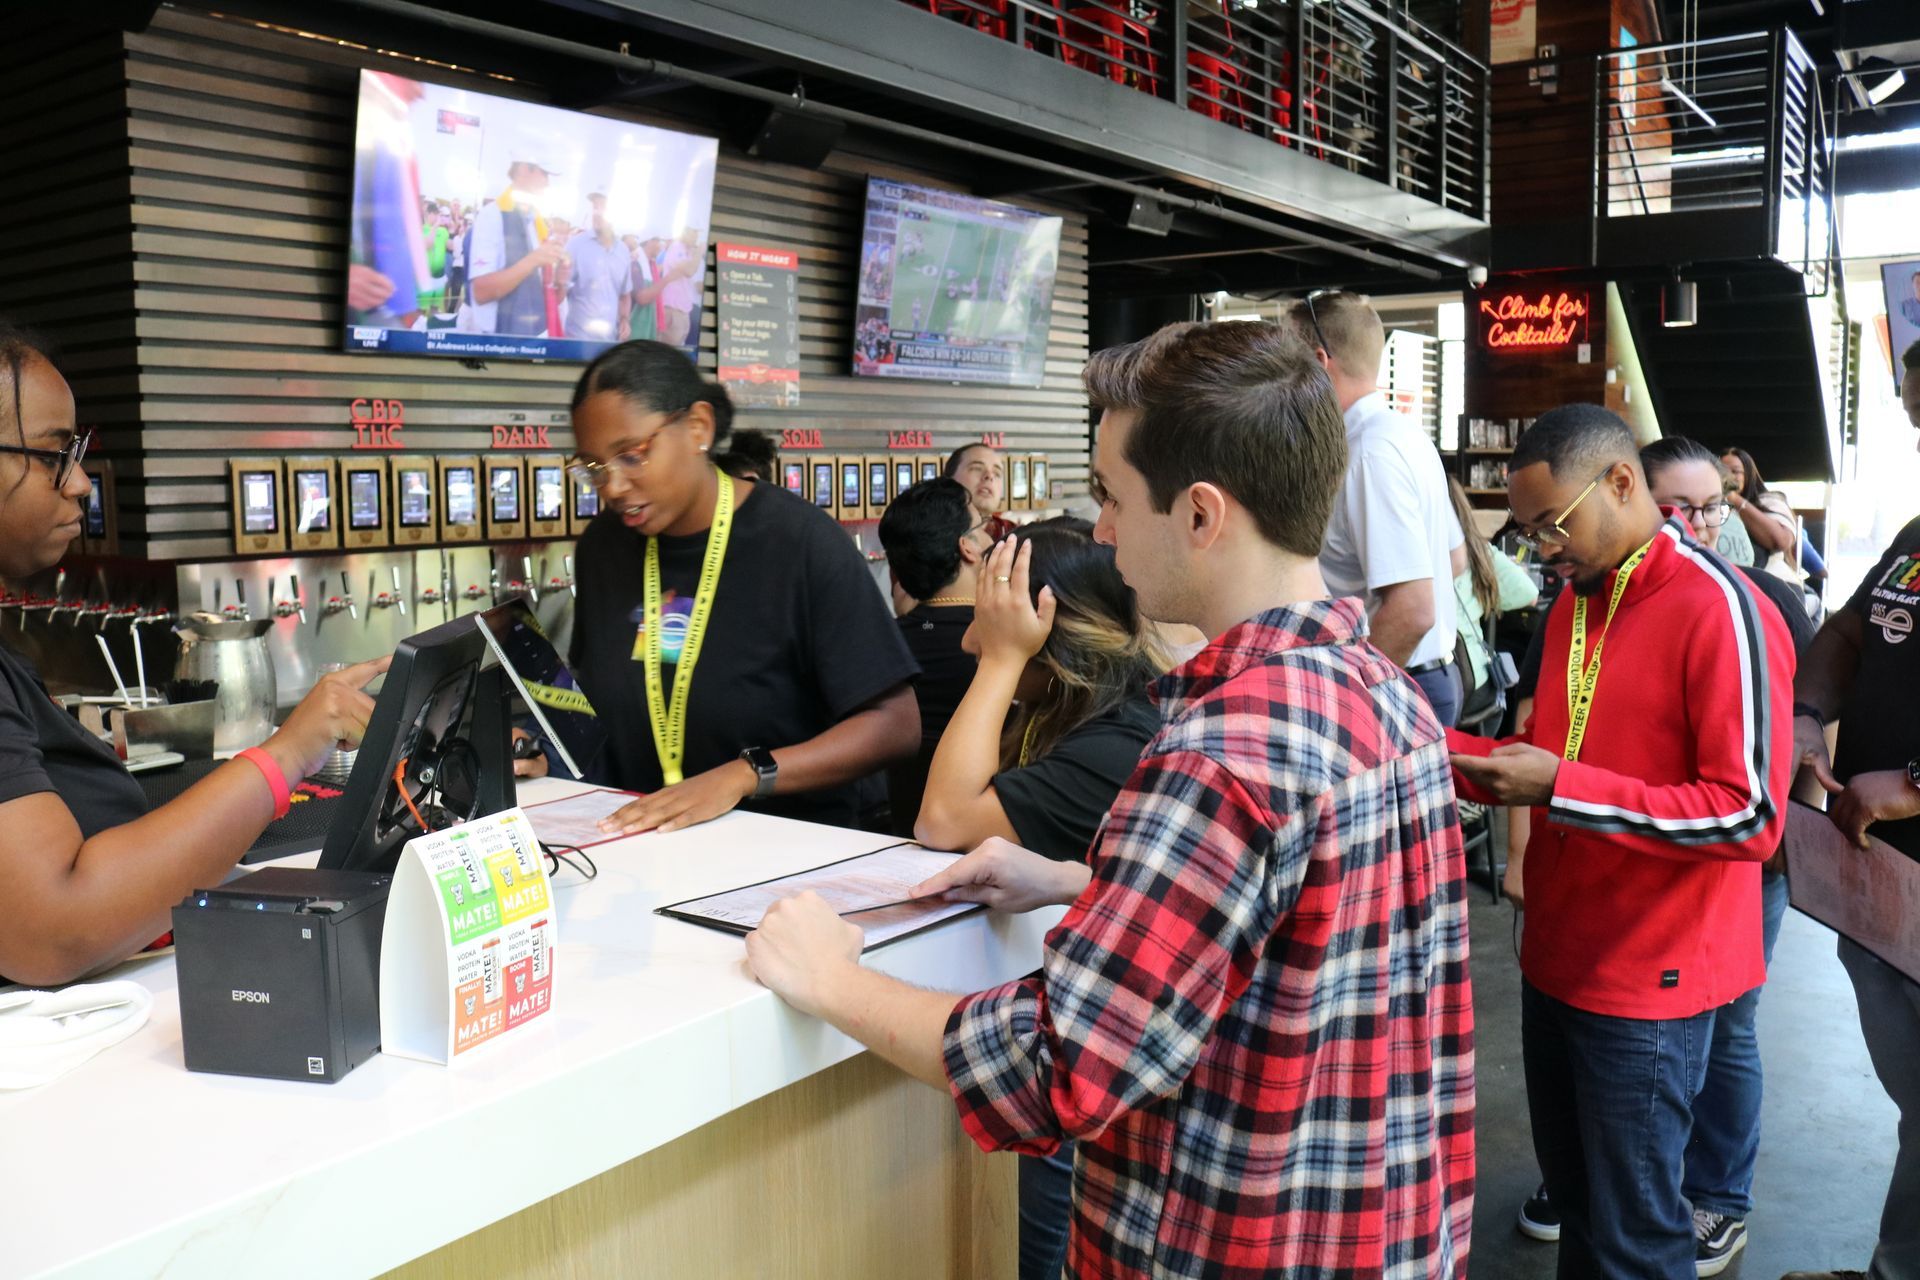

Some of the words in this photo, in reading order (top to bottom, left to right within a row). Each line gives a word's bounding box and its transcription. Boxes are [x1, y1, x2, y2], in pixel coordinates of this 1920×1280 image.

[749, 252, 760, 261] IT
[761, 254, 790, 266] WORKS
[1499, 294, 1552, 320] Climb
[1553, 292, 1586, 322] for
[1488, 320, 1577, 347] Cocktails!
[436, 342, 465, 350] Andrews
[901, 344, 935, 359] FALCONS
[936, 346, 950, 359] WIN
[351, 399, 404, 421] CBD
[354, 424, 403, 446] THC
[492, 425, 550, 446] DARK
[781, 429, 822, 446] SOUR
[889, 431, 932, 446] LAGER
[703, 532, 722, 593] VOLUNTEER
[682, 608, 704, 670] VOLUNTEER
[1566, 707, 1586, 762] OLUNTEER
[506, 829, 526, 866] MATE!
[456, 842, 477, 883] MATE!
[502, 884, 544, 912] MATE!
[453, 900, 497, 933] MATE!
[508, 929, 526, 941] VODKA
[509, 938, 530, 951] PROTEIN
[457, 949, 476, 961] VODKA
[510, 950, 527, 962] WATER
[532, 933, 540, 972] MATE!
[458, 958, 480, 973] PROTEIN
[459, 970, 478, 983] WATER
[483, 953, 492, 993] MATE!
[231, 990, 270, 1004] EPSON
[509, 987, 549, 1020] MATE!
[458, 1009, 502, 1044] MATE!
